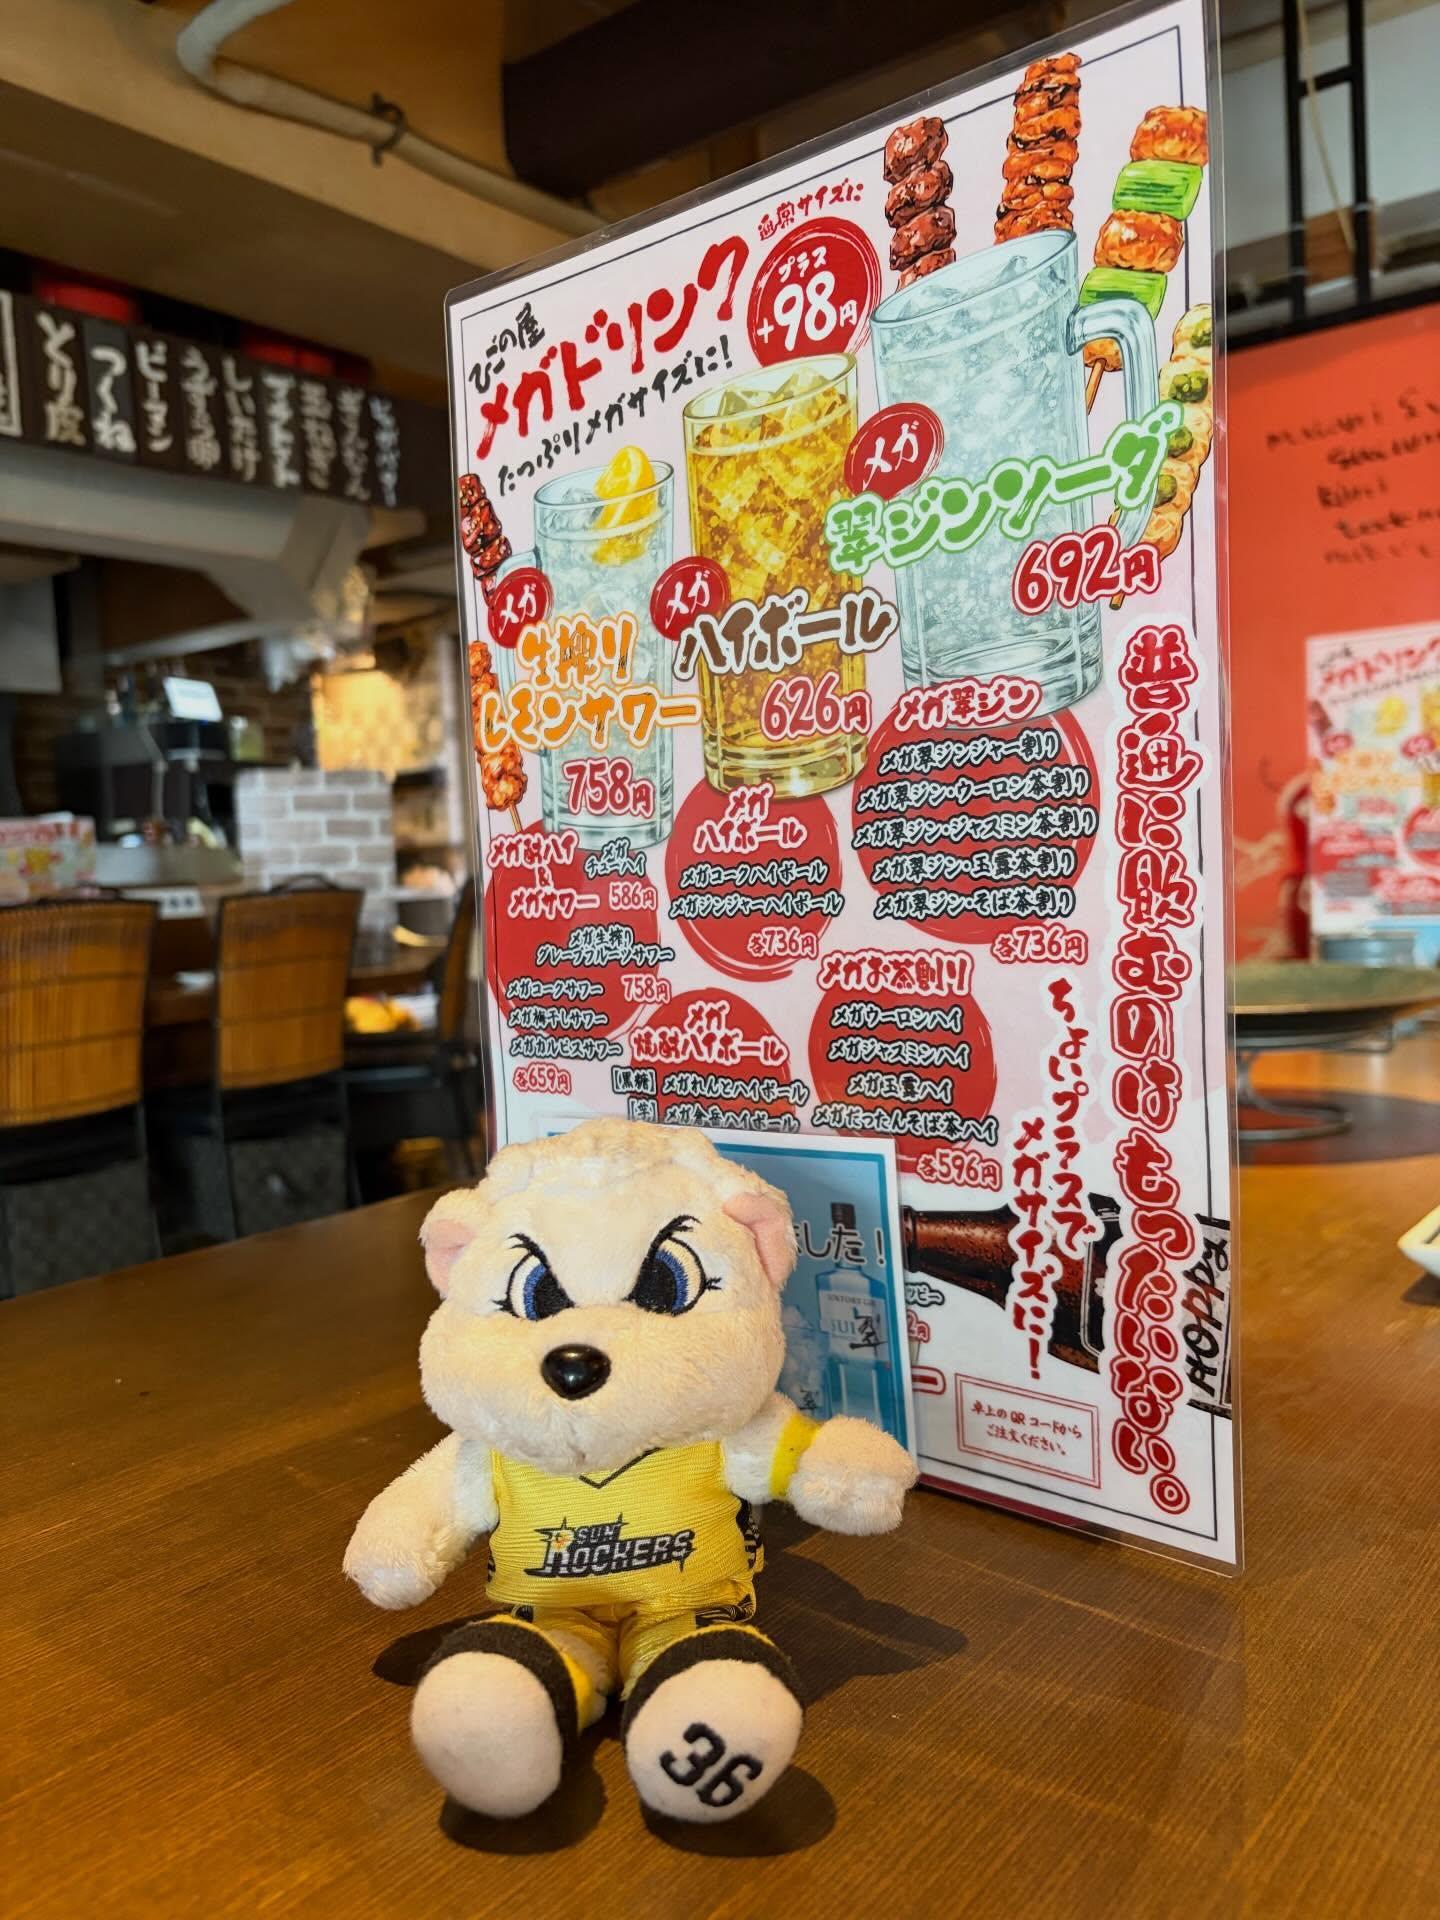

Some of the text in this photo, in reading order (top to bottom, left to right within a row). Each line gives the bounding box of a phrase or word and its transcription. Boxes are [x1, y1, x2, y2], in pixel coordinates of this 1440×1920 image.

[758, 178, 864, 241] 通常サイズに
[779, 246, 827, 283] プラス
[477, 235, 749, 460] メガドリンク
[90, 346, 137, 453] つくね
[862, 420, 920, 489] メガ
[825, 401, 1183, 576] 翠ジンソーダ
[1013, 525, 1162, 616] 692円
[499, 583, 538, 634] メガ
[665, 570, 711, 630] メガ
[673, 587, 899, 681] ハイボール
[481, 683, 702, 752] レモンサワー
[761, 671, 872, 741] 626円
[894, 676, 1042, 731] メガ翠ジン
[877, 727, 1061, 775] メガ翠ジンジャー割り
[563, 756, 655, 816] 758円
[725, 781, 774, 822] メガ
[601, 836, 632, 860] メガ
[693, 817, 807, 854] ハイボール
[583, 851, 647, 880] チューハイ
[679, 856, 829, 889] メガコークハイボール
[508, 887, 599, 920] メガサワー
[609, 881, 658, 910] 586円
[668, 887, 845, 920] メガジンジャーハイボール
[569, 922, 634, 948] メガ生搾り
[748, 925, 819, 960] 各736円
[990, 922, 1088, 964] 各736円
[536, 943, 675, 968] グレープフルーツサワー
[817, 948, 974, 996] メガお茶割り
[505, 977, 604, 1000] メガコークサワー
[620, 974, 673, 1004] 758円
[507, 1004, 609, 1031] メガ梅干しサワー
[685, 1000, 730, 1033] メガ
[829, 1000, 964, 1034] メガウーロンハイ
[629, 1027, 790, 1066] 焼酎ハイボール
[827, 1035, 971, 1070] メガジャスミンハイ
[512, 1061, 572, 1096] 各659円
[661, 1072, 809, 1108] メガれんとハイボール
[846, 1069, 954, 1106] メガ玉露ハイ
[811, 1100, 1000, 1147] メガだったんそば茶ハイ
[1048, 978, 1096, 1252] ちょいプラスで
[915, 1148, 1002, 1192] 各596円
[544, 1530, 695, 1577] ROCKERS
[575, 1525, 618, 1544] SUN
[660, 1722, 762, 1807] 36
